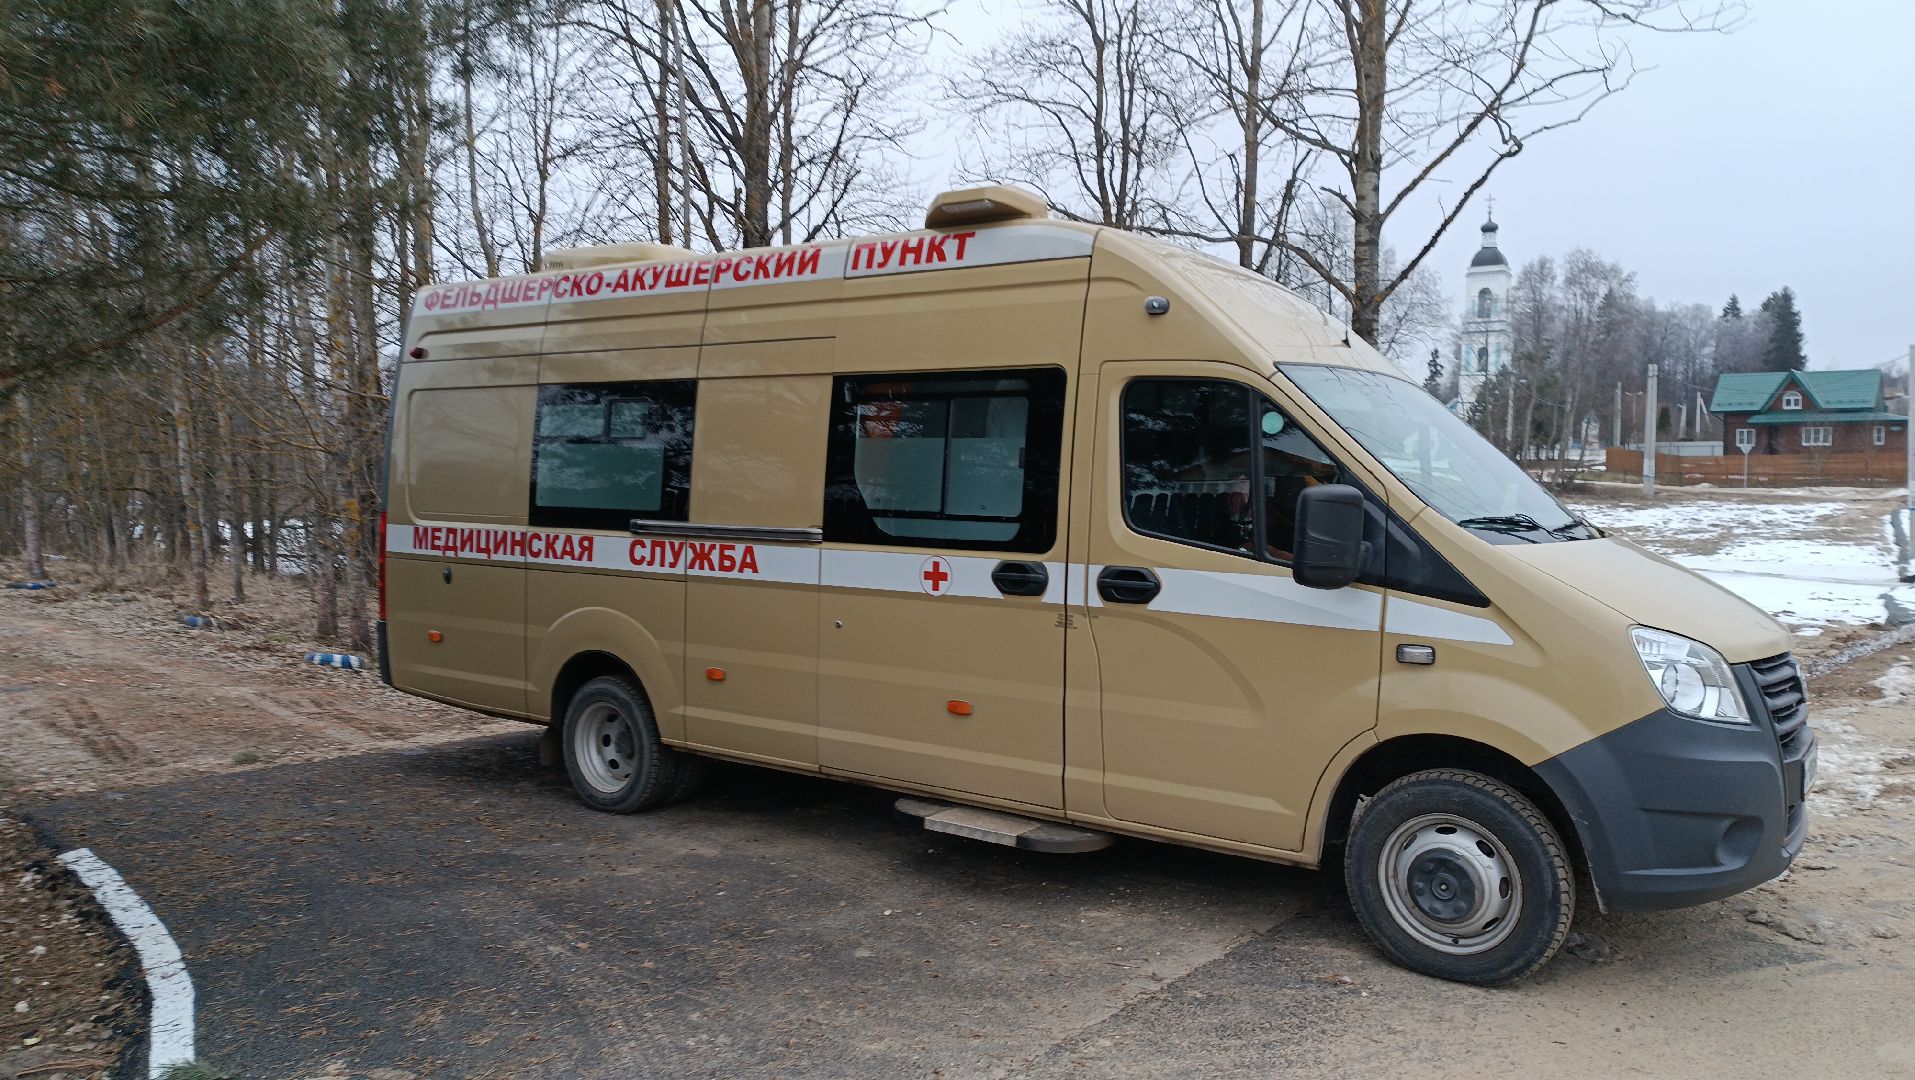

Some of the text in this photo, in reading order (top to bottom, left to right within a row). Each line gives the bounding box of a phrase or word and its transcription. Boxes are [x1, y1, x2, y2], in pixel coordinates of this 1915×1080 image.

[424, 230, 977, 311] ФЕЛЬДШЕРСКО-АКУШЕРСКИЙ ПУНКТ
[413, 526, 759, 575] МЕДИЦИНСКАЯ СЛУЖБА
